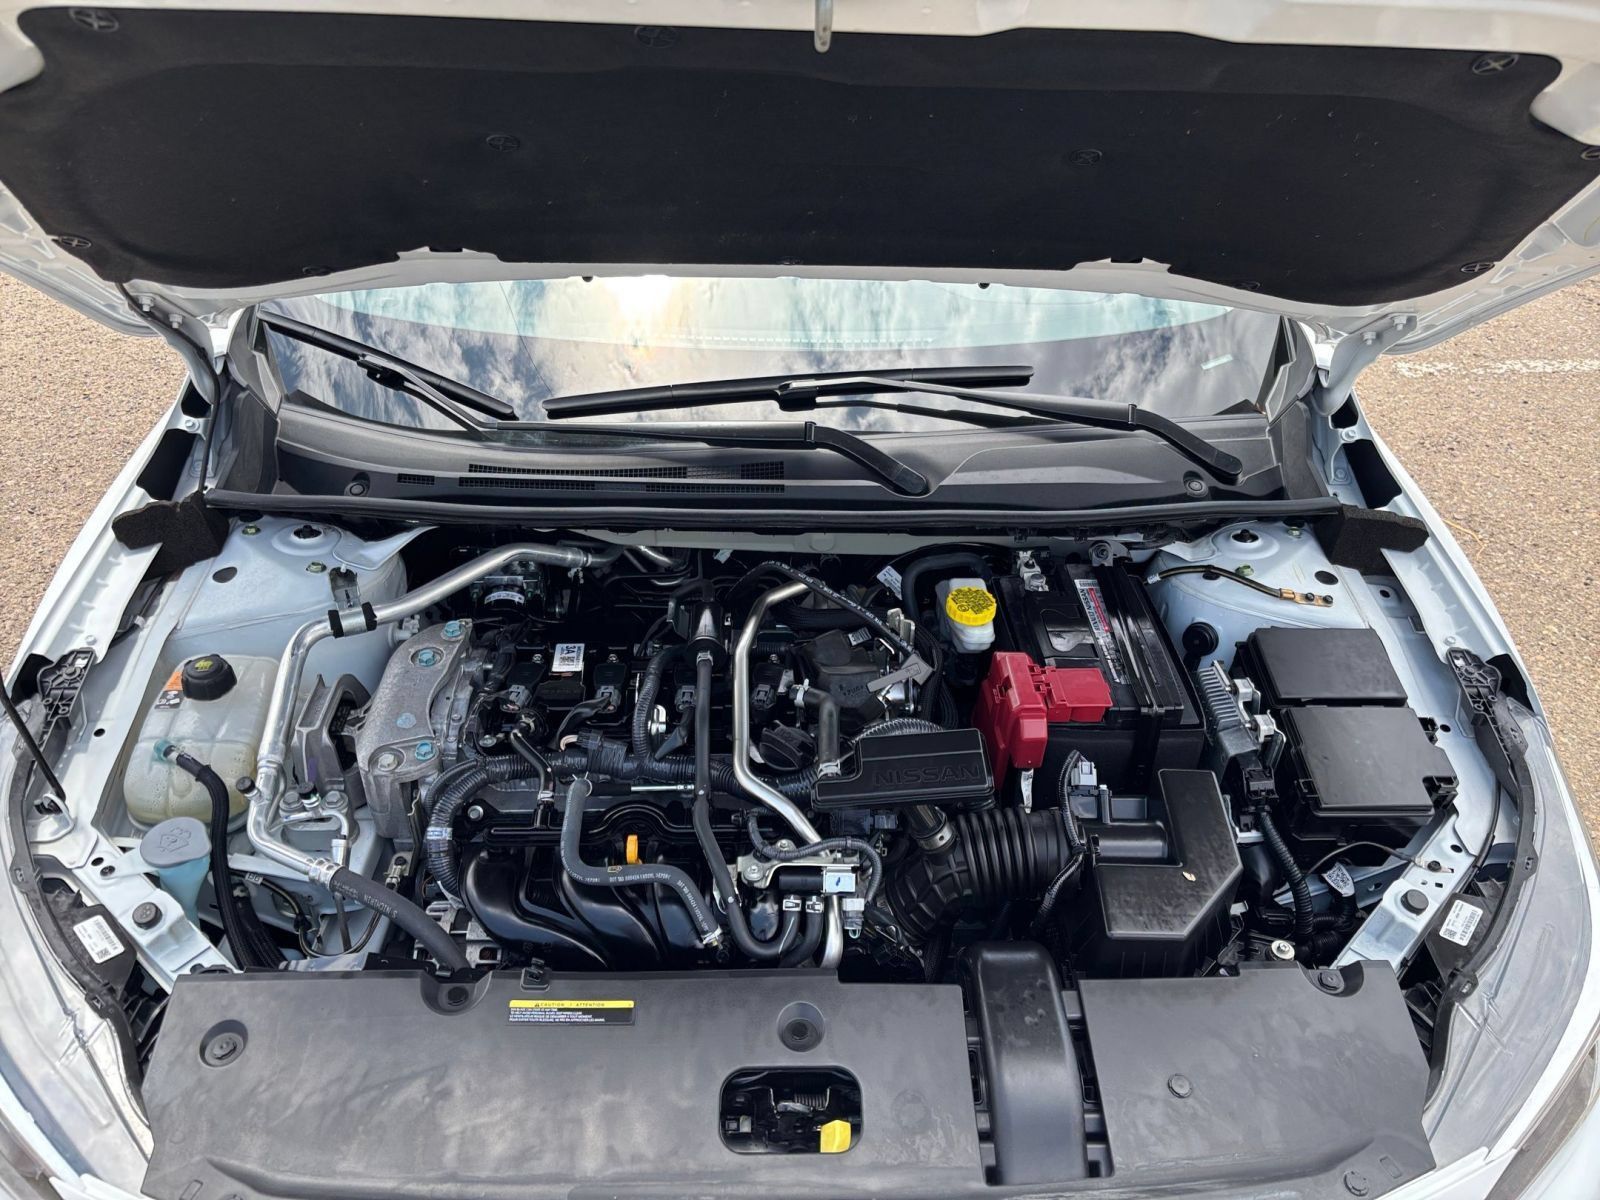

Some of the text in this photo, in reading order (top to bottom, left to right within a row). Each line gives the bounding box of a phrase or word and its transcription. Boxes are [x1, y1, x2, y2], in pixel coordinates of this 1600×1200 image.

[1080, 588, 1092, 610] NISSAN
[565, 645, 577, 655] 3A
[873, 765, 980, 786] NISSAN
